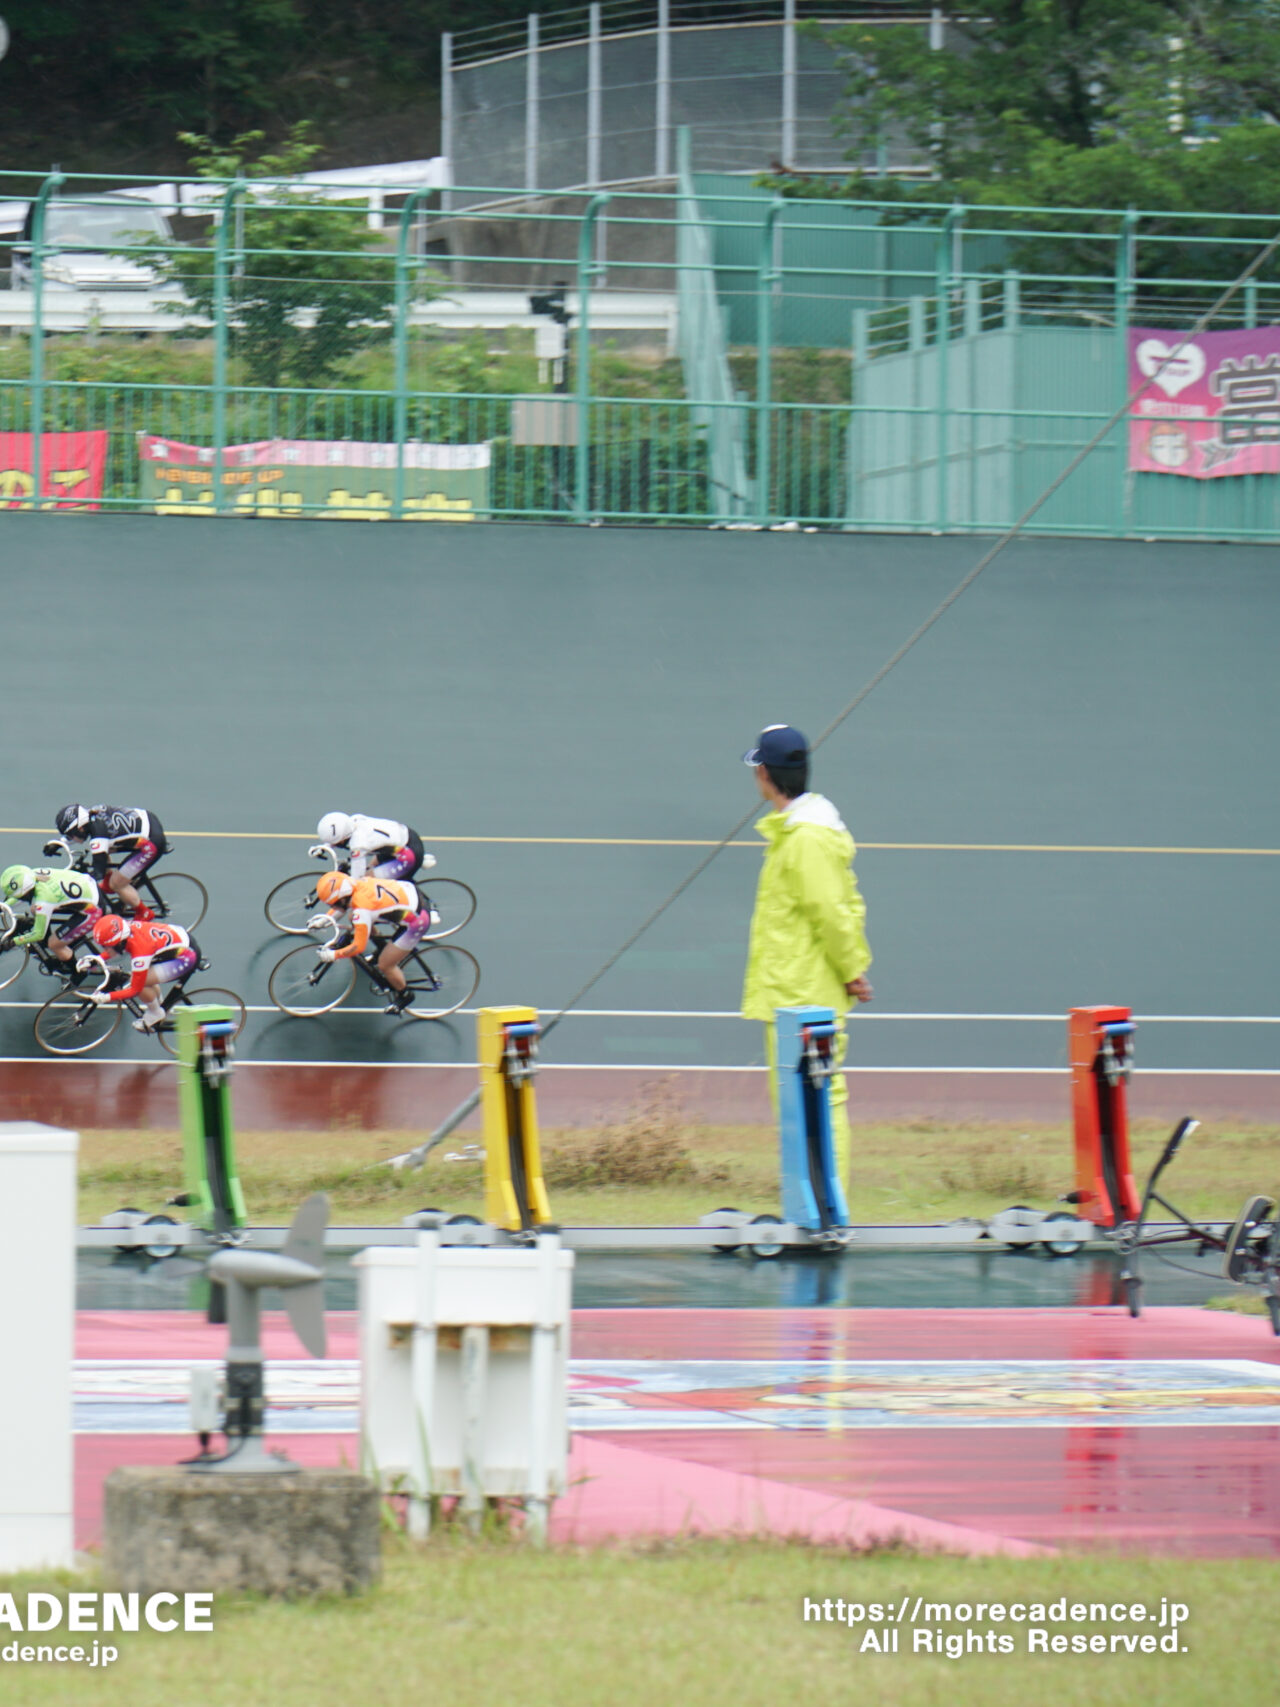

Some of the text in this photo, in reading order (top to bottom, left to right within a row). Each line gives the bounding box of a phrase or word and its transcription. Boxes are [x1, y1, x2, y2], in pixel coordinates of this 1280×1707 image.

[111, 812, 136, 834] 2
[10, 877, 18, 890] 6
[60, 881, 82, 899] 6
[376, 884, 399, 904] 7
[150, 927, 172, 946] 3
